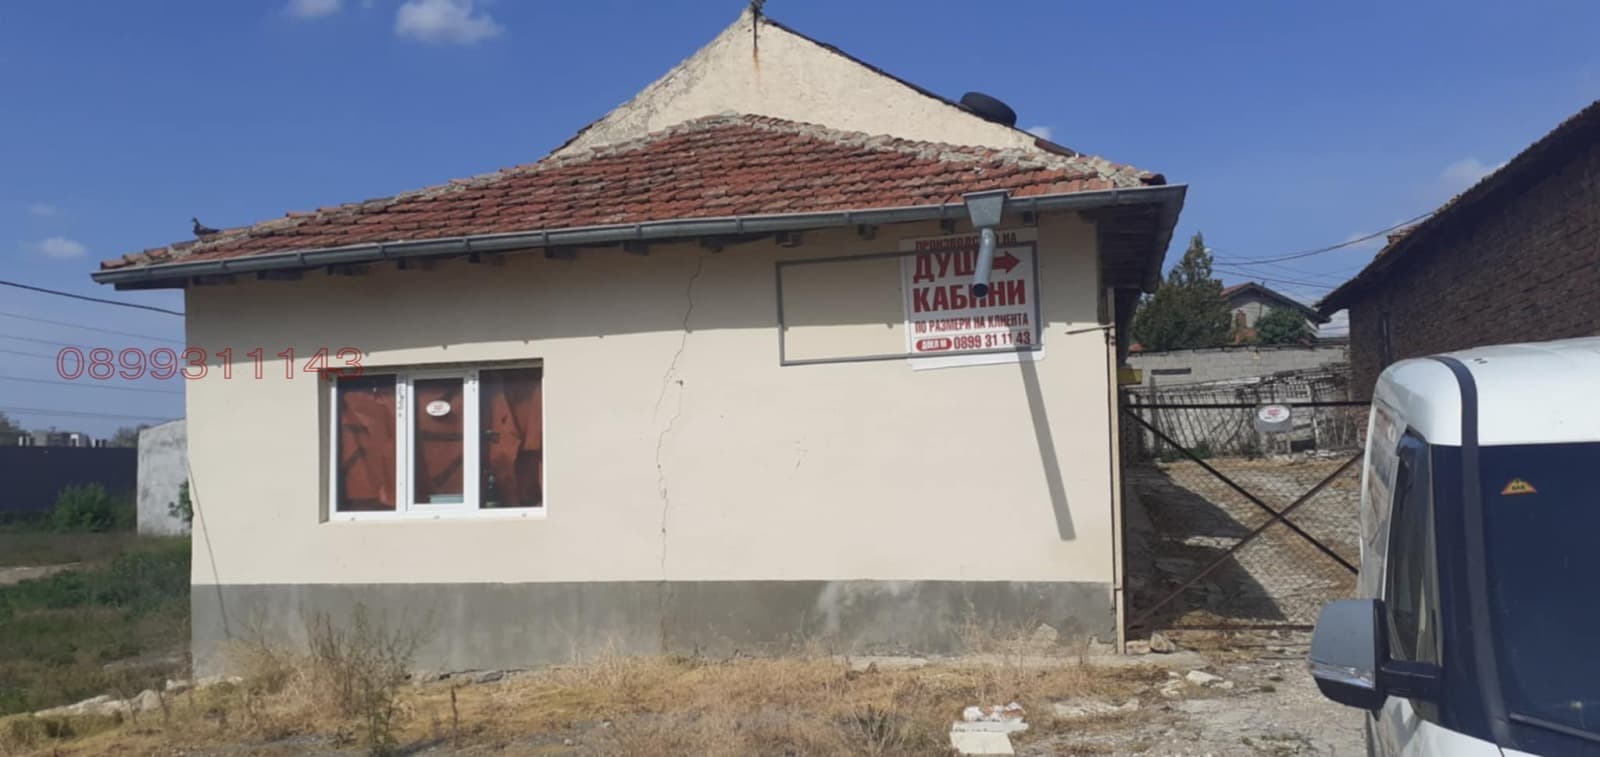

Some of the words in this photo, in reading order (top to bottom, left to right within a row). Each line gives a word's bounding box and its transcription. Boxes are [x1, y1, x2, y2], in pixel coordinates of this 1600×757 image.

[915, 320, 927, 333] ПО
[929, 317, 970, 332] РАЗМЕРИ
[973, 316, 985, 328] НА
[988, 312, 1029, 328] КЛИЕНТА
[953, 335, 982, 349] 0899
[985, 334, 997, 347] 31
[1002, 333, 1013, 345] 11
[1016, 331, 1031, 344] 43
